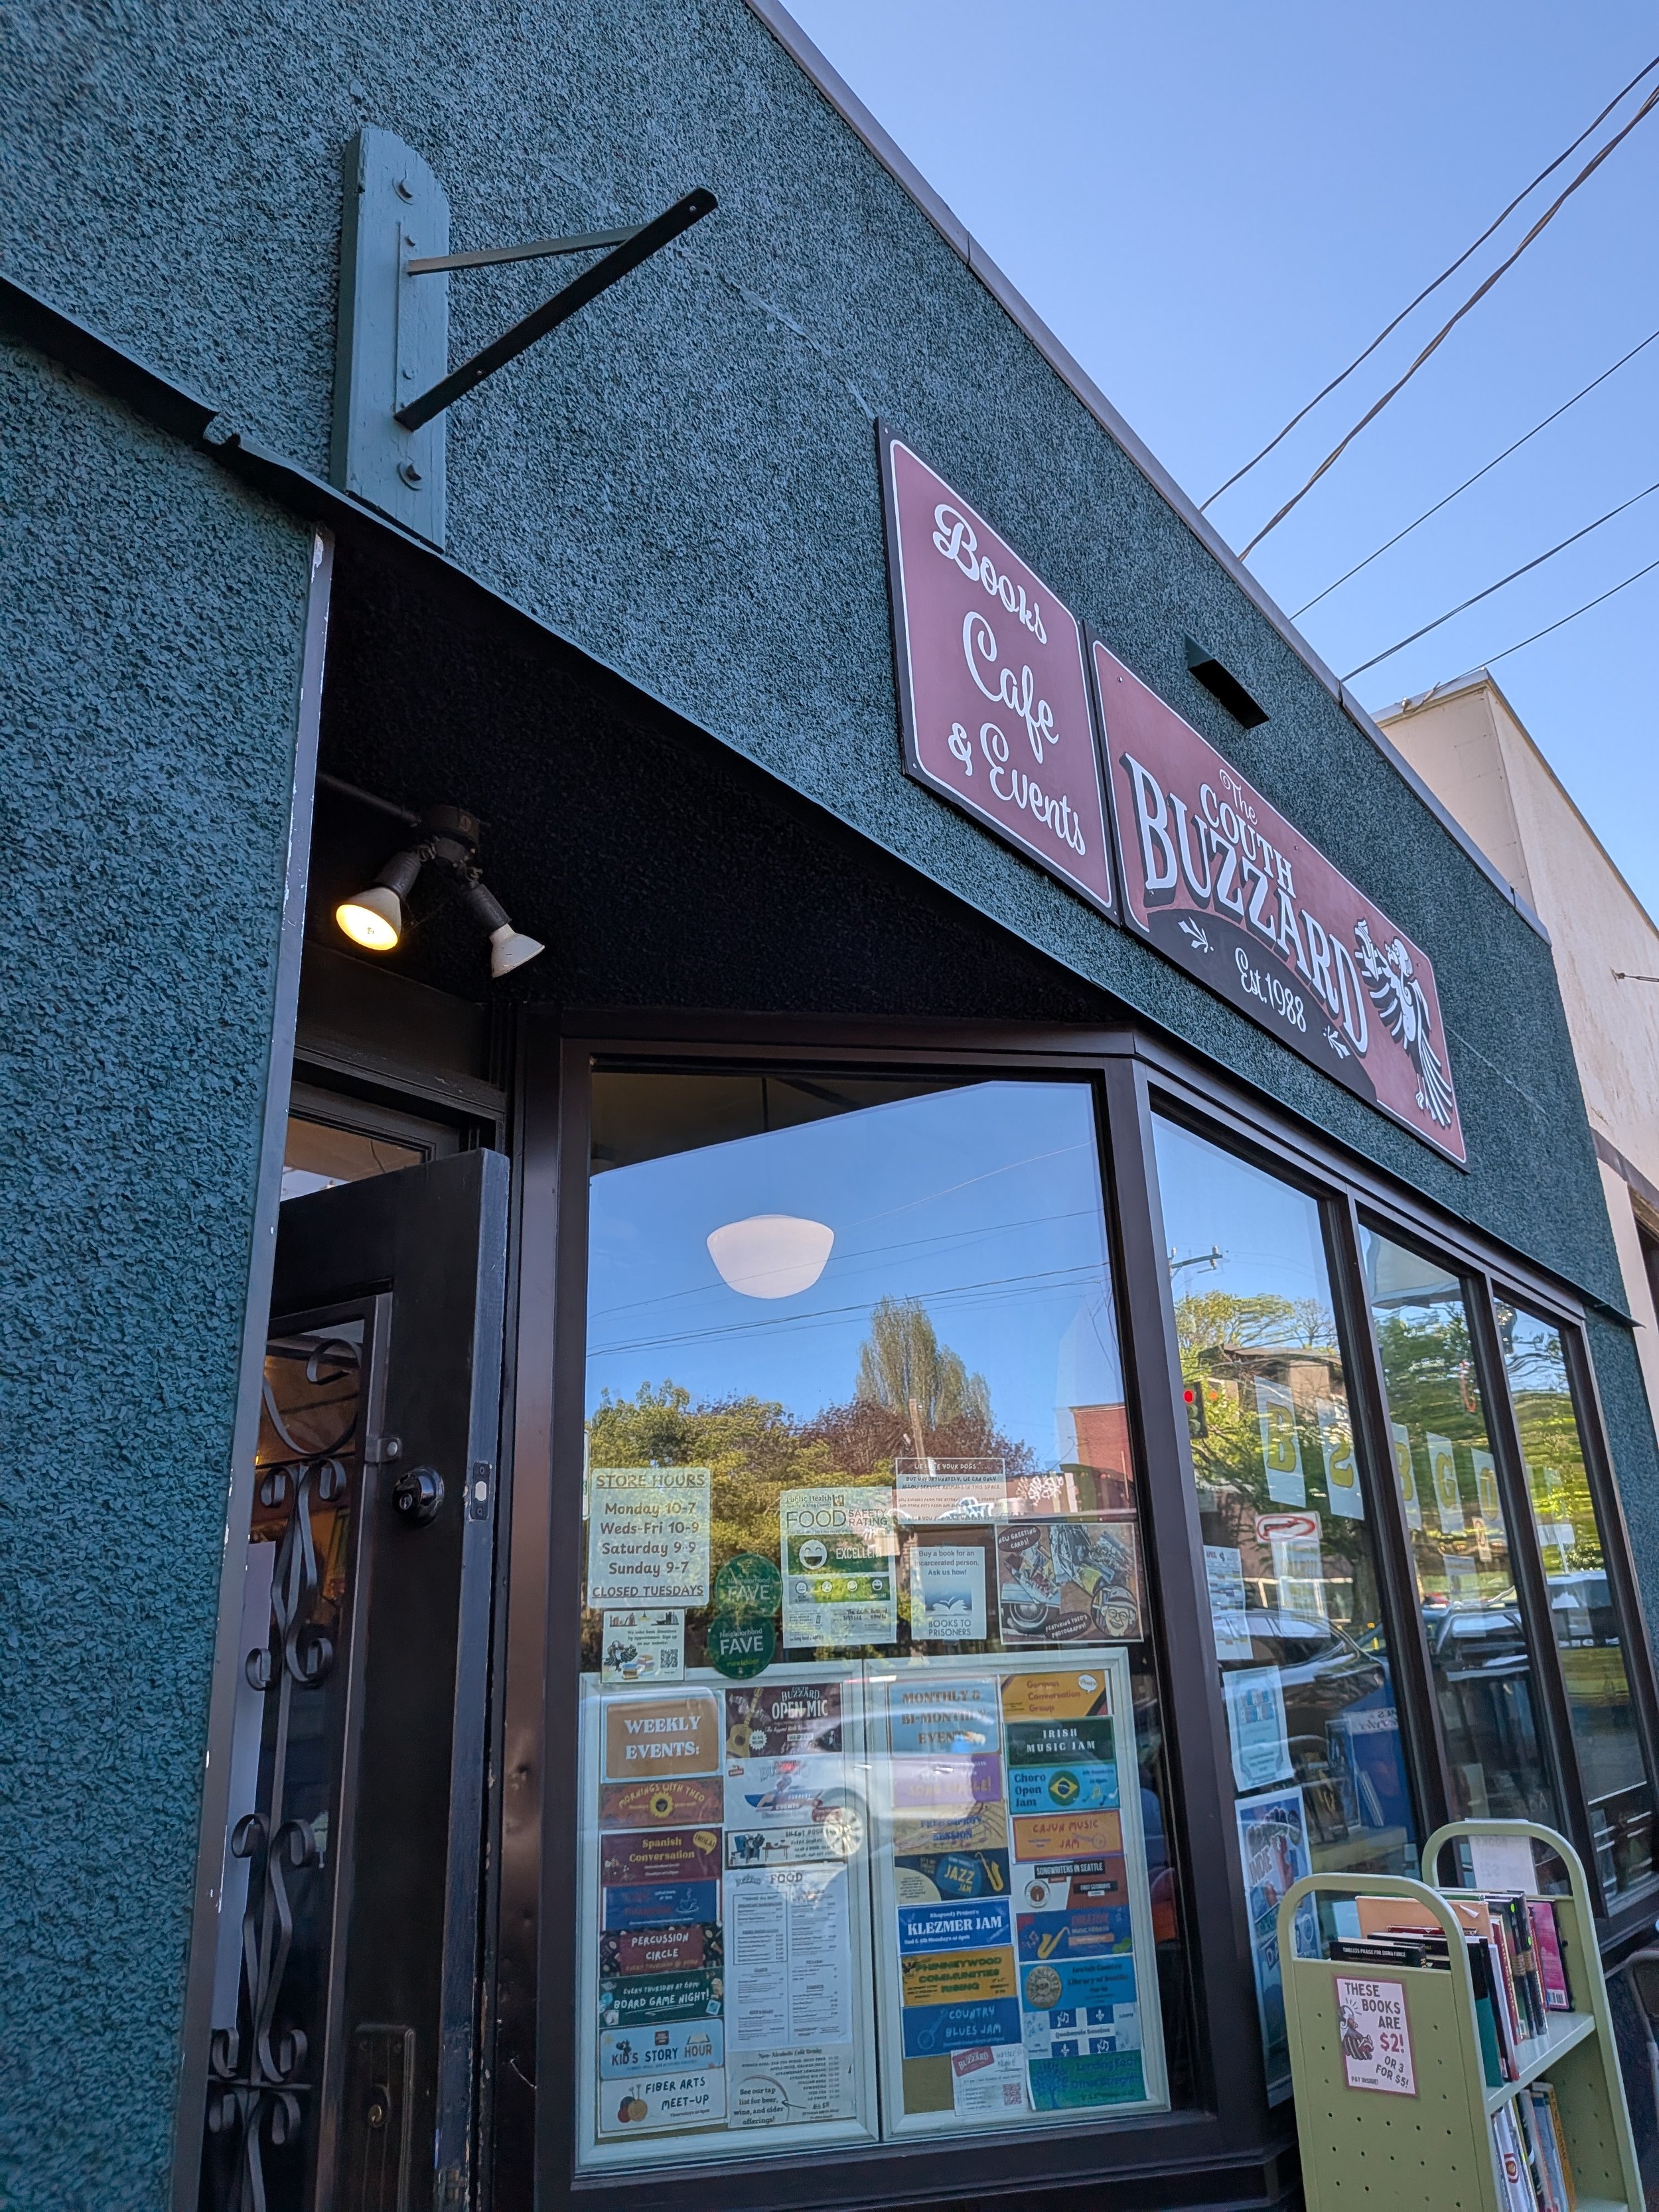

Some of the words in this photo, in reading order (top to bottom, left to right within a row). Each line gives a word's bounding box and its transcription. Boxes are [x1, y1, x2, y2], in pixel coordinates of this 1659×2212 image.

[932, 504, 1047, 644] Books
[962, 611, 1060, 764] Cafe
[948, 722, 973, 776] &
[980, 722, 1086, 855] Events
[1218, 769, 1258, 825] The
[1200, 783, 1297, 899] COUTH
[1125, 753, 1368, 1054] BUZZARD
[1264, 972, 1307, 1033] 1988
[596, 1475, 646, 1487] STORE
[653, 1474, 705, 1487] HOURS
[786, 1495, 808, 1503] Public
[605, 1502, 660, 1518] Monday
[667, 1502, 697, 1514] 10-7
[786, 1510, 847, 1528] FOOD
[848, 1509, 887, 1518] SAFETY
[849, 1517, 888, 1526] RATING
[600, 1522, 663, 1534] Weds-Fri
[668, 1521, 699, 1534] 10-9
[998, 1535, 1010, 1545] NEW
[1010, 1527, 1037, 1540] GREETING
[1010, 1536, 1029, 1550] CARDS!
[602, 1541, 668, 1558] Saturday
[835, 1546, 883, 1560] EXCELLENT
[609, 1561, 661, 1578] Sunday
[666, 1561, 689, 1574] 9-7
[593, 1586, 639, 1597] CLOSED
[643, 1585, 704, 1597] TUESDAYS
[727, 1584, 770, 1603] FAVE
[928, 1619, 958, 1628] BOOKS
[1071, 1613, 1088, 1624] THEO'S
[719, 1628, 763, 1638] Neighborhood
[928, 1628, 972, 1637] PRISONERS
[720, 1635, 764, 1656] FAVE
[781, 1689, 820, 1702] BUZZARD
[902, 1690, 969, 1705] MONTHLY
[1028, 1691, 1081, 1701] Conversation
[771, 1700, 804, 1720] OPEN
[806, 1699, 829, 1718] MIC
[1029, 1704, 1055, 1713] Group
[624, 1716, 701, 1735] WEEKLY
[1043, 1728, 1078, 1739] IRISH
[625, 1741, 700, 1760] EVENTS:
[1026, 1742, 1066, 1753] MUSIC
[1072, 1740, 1096, 1751] JAM
[1014, 1773, 1046, 1783] Choro
[619, 1783, 660, 1810] MORNINGS
[662, 1782, 684, 1792] WITH
[685, 1786, 705, 1803] THEO
[1015, 1786, 1042, 1797] Open
[1015, 1799, 1037, 1807] Jam
[1033, 1824, 1065, 1834] CAJUN
[1068, 1820, 1100, 1831] MUSIC
[642, 1836, 682, 1850] Spanish
[1059, 1838, 1080, 1849] JAM
[629, 1850, 695, 1862] Conversation
[944, 1864, 975, 1885] JAZZ
[1036, 1864, 1074, 1876] SONGWRITERS
[1074, 1864, 1080, 1874] IN
[1080, 1862, 1104, 1872] SEATTLE
[770, 1872, 804, 1884] FOOD
[958, 1884, 973, 1893] JAM
[907, 1919, 974, 1936] KLEZMER
[975, 1915, 1003, 1930] JAM
[631, 1932, 689, 1947] PERCUSSION
[646, 1948, 679, 1961] CIRCLE
[1344, 1982, 1381, 1998] THESE
[613, 1998, 646, 2010] BOARD
[648, 1994, 676, 2006] GAME
[678, 1988, 710, 2004] NIGHT!
[1361, 1998, 1401, 2015] BOOKS
[948, 2005, 995, 2020] COUNTRY
[1378, 2015, 1402, 2030] ARE
[946, 2026, 977, 2038] BLUES
[980, 2024, 1002, 2035] JAM
[1380, 2031, 1405, 2054] $2!
[611, 2051, 639, 2067] KID'S
[645, 2047, 679, 2063] STORY
[684, 2043, 713, 2058] HOUR
[1384, 2055, 1397, 2070] OR
[1398, 2063, 1405, 2074] 3
[1361, 2077, 1379, 2085] INSIDE!
[1375, 2064, 1393, 2081] FOR
[1395, 2073, 1409, 2089] $5!
[645, 2081, 676, 2095] FIBER
[680, 2076, 707, 2091] ARTS
[661, 2093, 709, 2111] MEET-UP
[742, 2116, 775, 2125] offerings!
